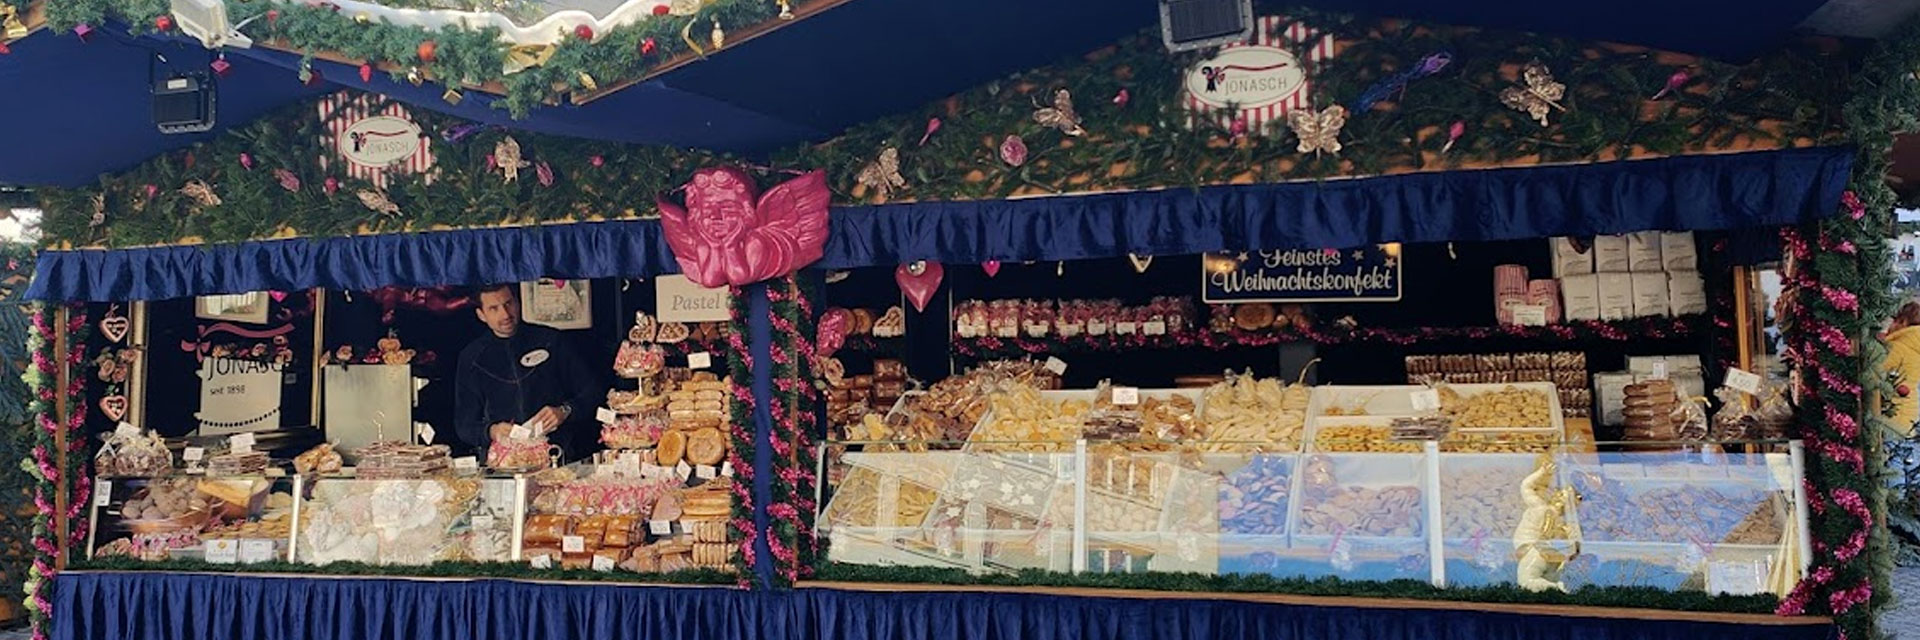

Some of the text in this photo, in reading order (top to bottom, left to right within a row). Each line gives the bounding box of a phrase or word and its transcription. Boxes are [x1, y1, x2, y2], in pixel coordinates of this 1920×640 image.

[1225, 77, 1287, 95] JONASCH
[366, 140, 409, 156] JONASCH
[1259, 248, 1341, 268] Feinstes
[1211, 265, 1392, 296] Weihnachtskonfekt
[672, 292, 720, 311] Pastel
